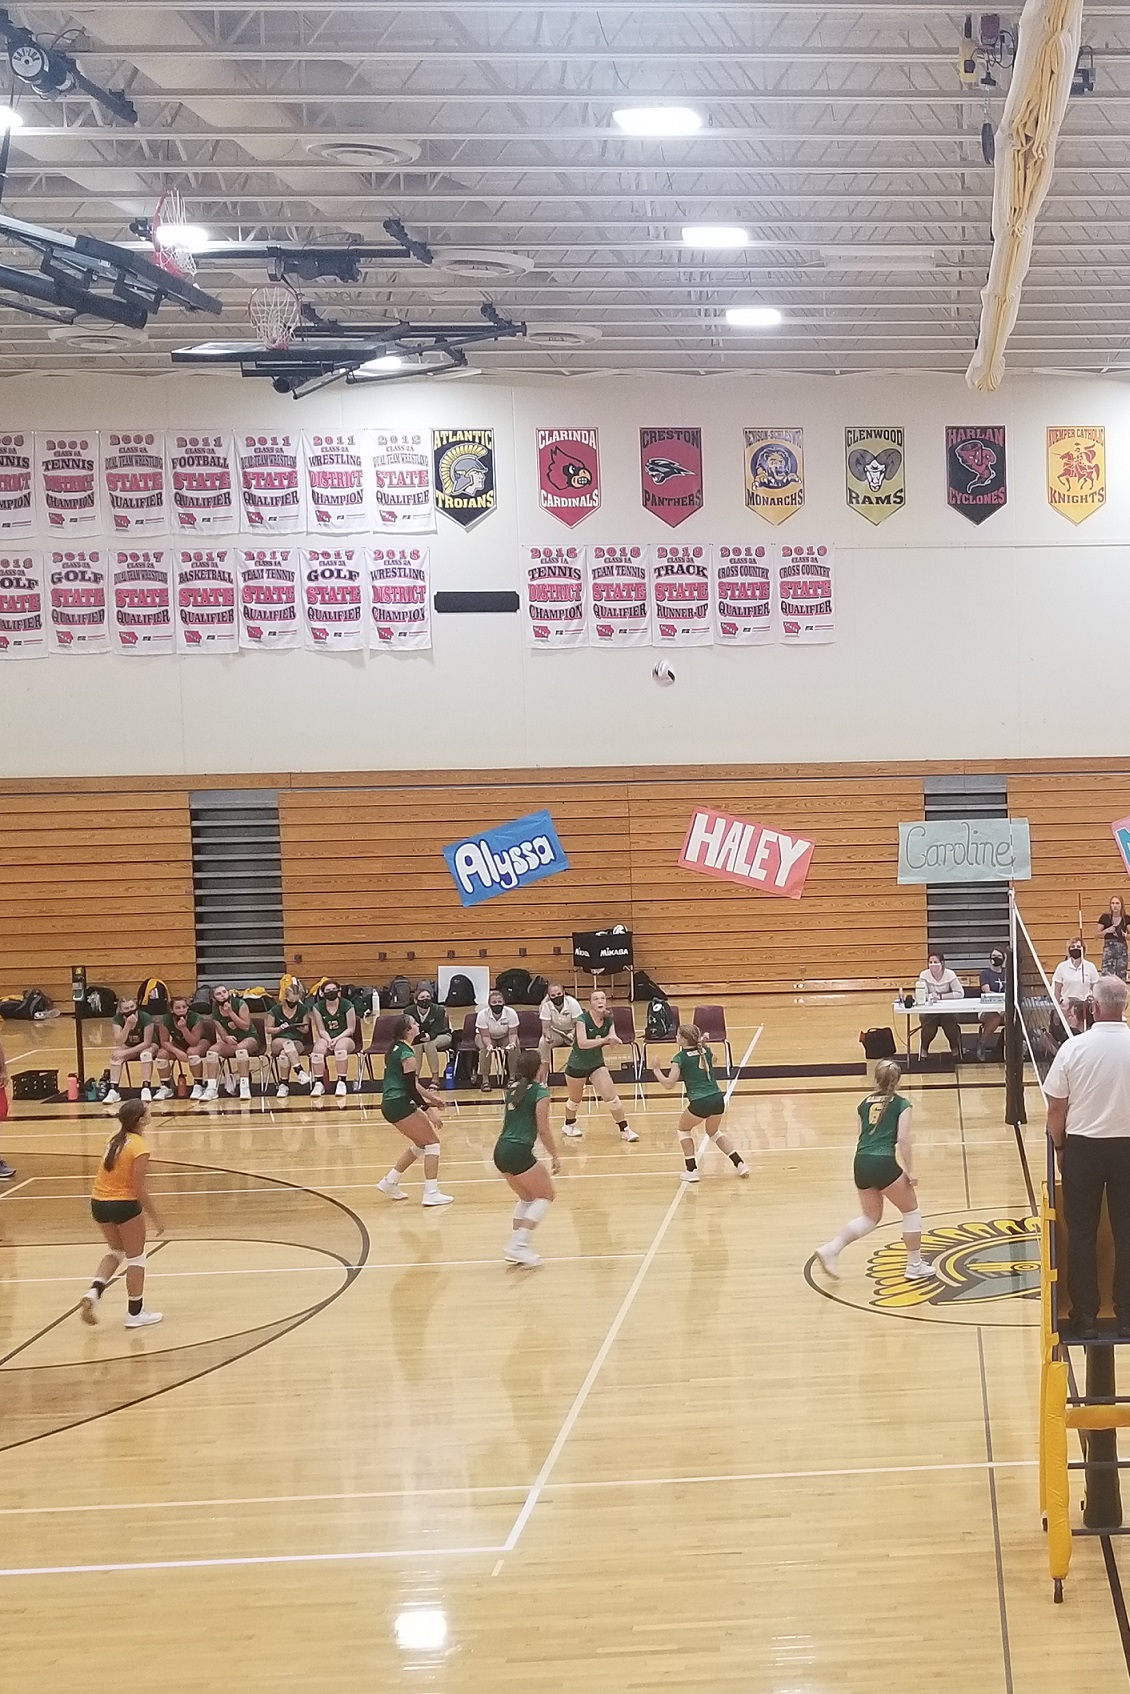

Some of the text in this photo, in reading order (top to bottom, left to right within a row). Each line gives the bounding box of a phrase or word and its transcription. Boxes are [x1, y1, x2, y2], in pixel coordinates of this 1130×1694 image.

[177, 436, 222, 448] 2011
[246, 436, 291, 447] 2011
[313, 435, 356, 446] 2011
[378, 435, 421, 446] 2012
[434, 431, 492, 448] ATLANTIC
[538, 430, 597, 449] CLARINDA
[642, 430, 700, 448] CRESTON
[847, 429, 903, 447] GLENWOOD
[947, 429, 1003, 447] HARLAN
[43, 458, 94, 471] TENNIS
[171, 456, 229, 469] FOOTBALL
[308, 453, 361, 468] WRESTLING
[400, 453, 428, 467] WRESTLING
[106, 472, 163, 492] STATE
[173, 471, 231, 490] STATE
[242, 470, 298, 490] STATE
[309, 470, 363, 488] DISTRICT
[376, 469, 429, 488] STATE
[0, 492, 31, 510] MPION
[46, 491, 94, 509] CHAMPION
[109, 492, 163, 509] QUALIFIER
[174, 491, 232, 508] QUALIFIER
[243, 490, 299, 507] QUALIFIER
[312, 488, 363, 505] CHAMPION
[376, 489, 429, 506] QUALIFIER
[435, 489, 494, 508] TROJANS
[541, 489, 598, 507] CARDINALS
[643, 489, 701, 506] PANTHERS
[747, 489, 803, 506] MONARCHS
[848, 487, 903, 505] RAMS
[949, 487, 1005, 505] CYCLONES
[1049, 487, 1105, 504] KNIGHTS
[117, 552, 164, 563] 2017
[181, 551, 227, 563] 2017
[245, 551, 291, 560] 2017
[309, 550, 354, 561] 2017
[373, 549, 420, 560] 2018
[782, 546, 827, 557] 2019
[51, 570, 103, 585] GOLF
[178, 569, 233, 585] BASKETBALL
[242, 569, 295, 583] TEAM TENNIS
[307, 568, 360, 582] GOLF
[370, 568, 425, 582] WRESTLING
[528, 566, 581, 581] TENNIS
[592, 565, 645, 580] TEAM TENNIS
[654, 564, 708, 579] TRACK
[718, 565, 769, 580] CROSS COUNTRY
[780, 565, 830, 578] CROSS COUNTRY
[0, 578, 39, 590] OLF
[528, 583, 582, 602] DISTRICT
[592, 582, 646, 601] STATE
[655, 582, 709, 601] STATE
[718, 581, 770, 600] STATE
[780, 580, 831, 599] STATE
[51, 588, 105, 607] STATE
[115, 588, 169, 607] STATE
[179, 588, 234, 607] STATE
[242, 585, 295, 604] STATE
[306, 586, 361, 604] STATE
[372, 585, 426, 603] DISTRICT
[0, 593, 41, 613] TATE
[593, 603, 647, 619] QUALIFIER
[656, 603, 708, 619] RUNNER-UP
[719, 601, 770, 617] QUALIFIER
[781, 600, 832, 616] QUALIFIER
[52, 609, 104, 625] QUALIFIER
[116, 609, 170, 626] QUALIFIER
[181, 609, 234, 625] QUALIFIER
[243, 605, 296, 621] QUALIFIER
[308, 606, 361, 622] QUALIFIER
[529, 603, 582, 621] CHAMPION
[685, 813, 811, 887] HALEY
[904, 822, 1015, 869] Caroline
[454, 834, 555, 894] Alyssa
[327, 1020, 340, 1030] 12
